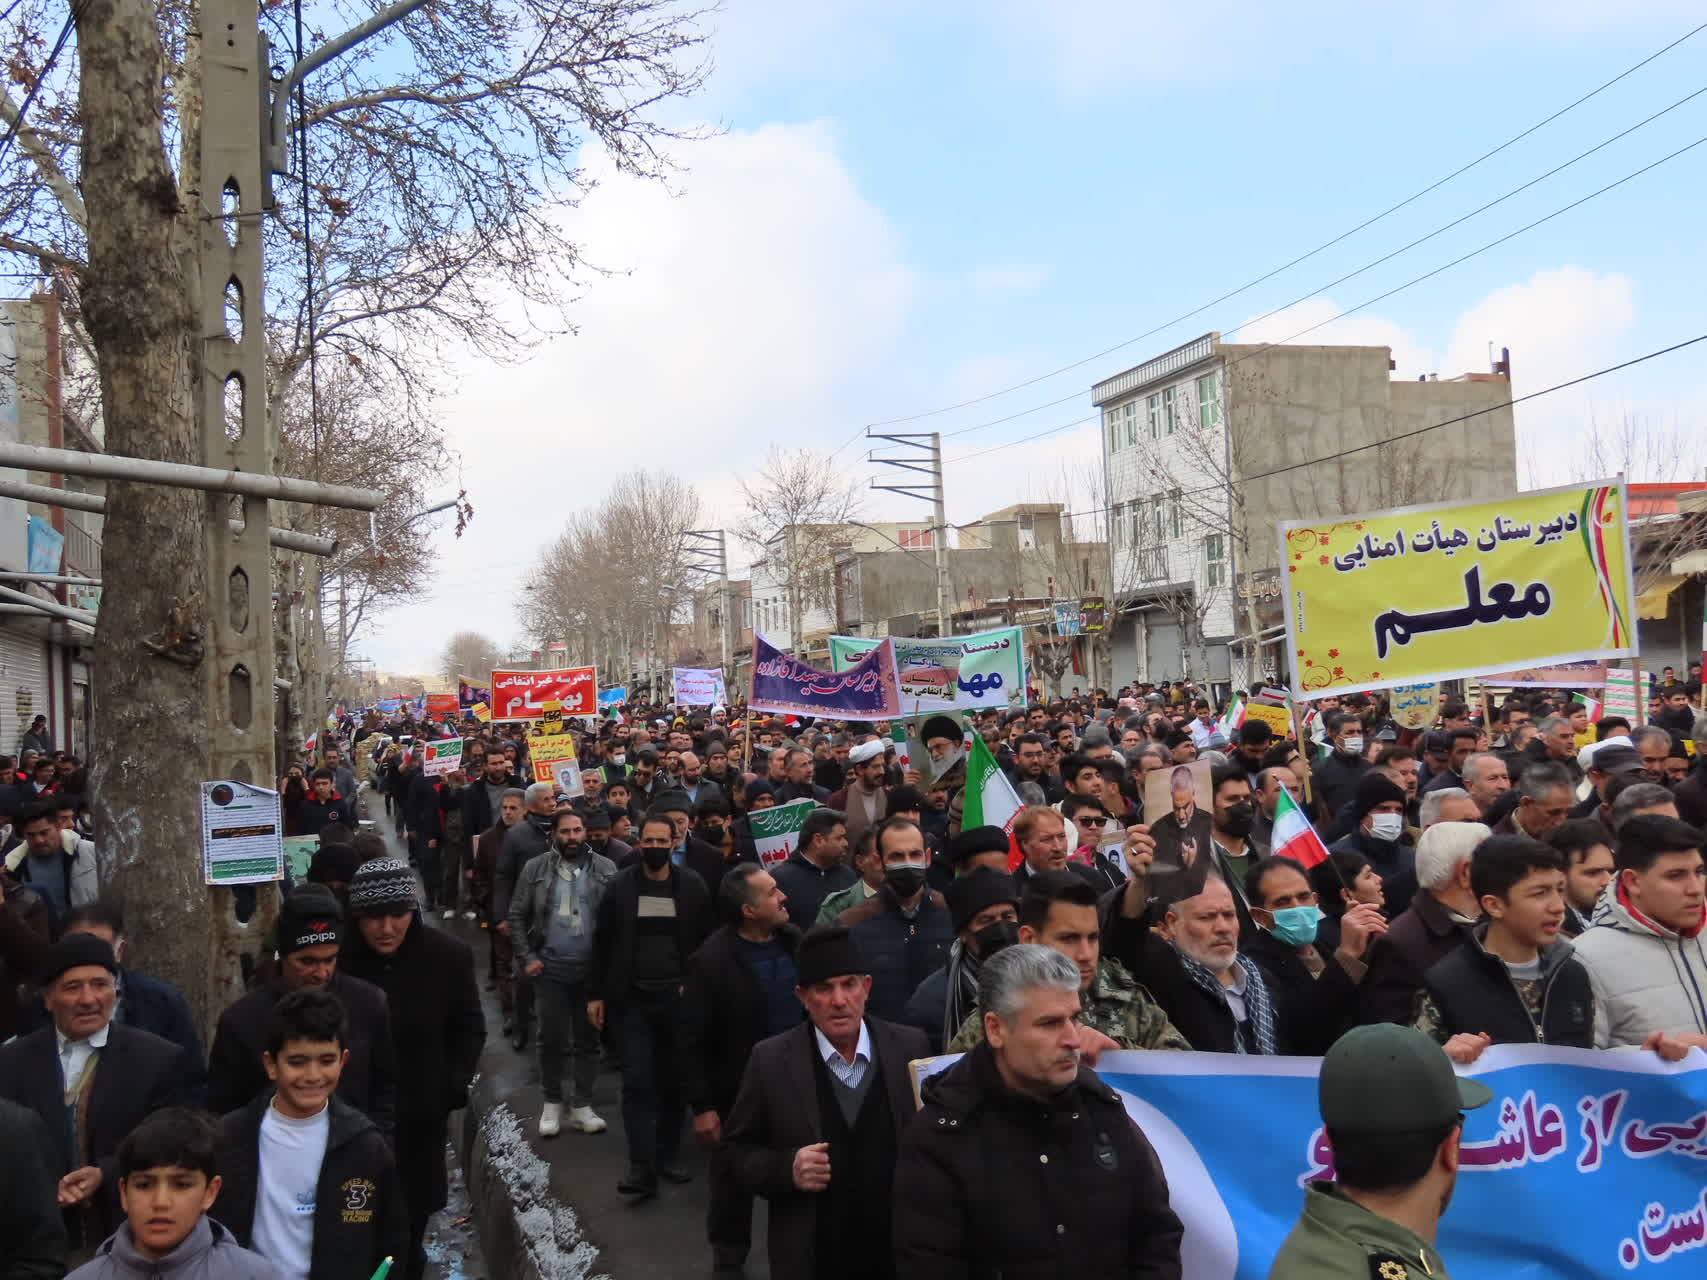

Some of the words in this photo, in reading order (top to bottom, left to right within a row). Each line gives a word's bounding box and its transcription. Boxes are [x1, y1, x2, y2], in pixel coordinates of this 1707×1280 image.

[1411, 520, 1468, 556] هیأت
[1477, 511, 1577, 550] دبیرستان
[1334, 530, 1405, 571] امنایی
[1375, 564, 1551, 659] معلم
[495, 675, 535, 689] انتفاعی
[535, 675, 553, 689] غیر
[506, 690, 583, 717] بهنام
[1578, 1090, 1626, 1169] از
[346, 1184, 368, 1209] 3
